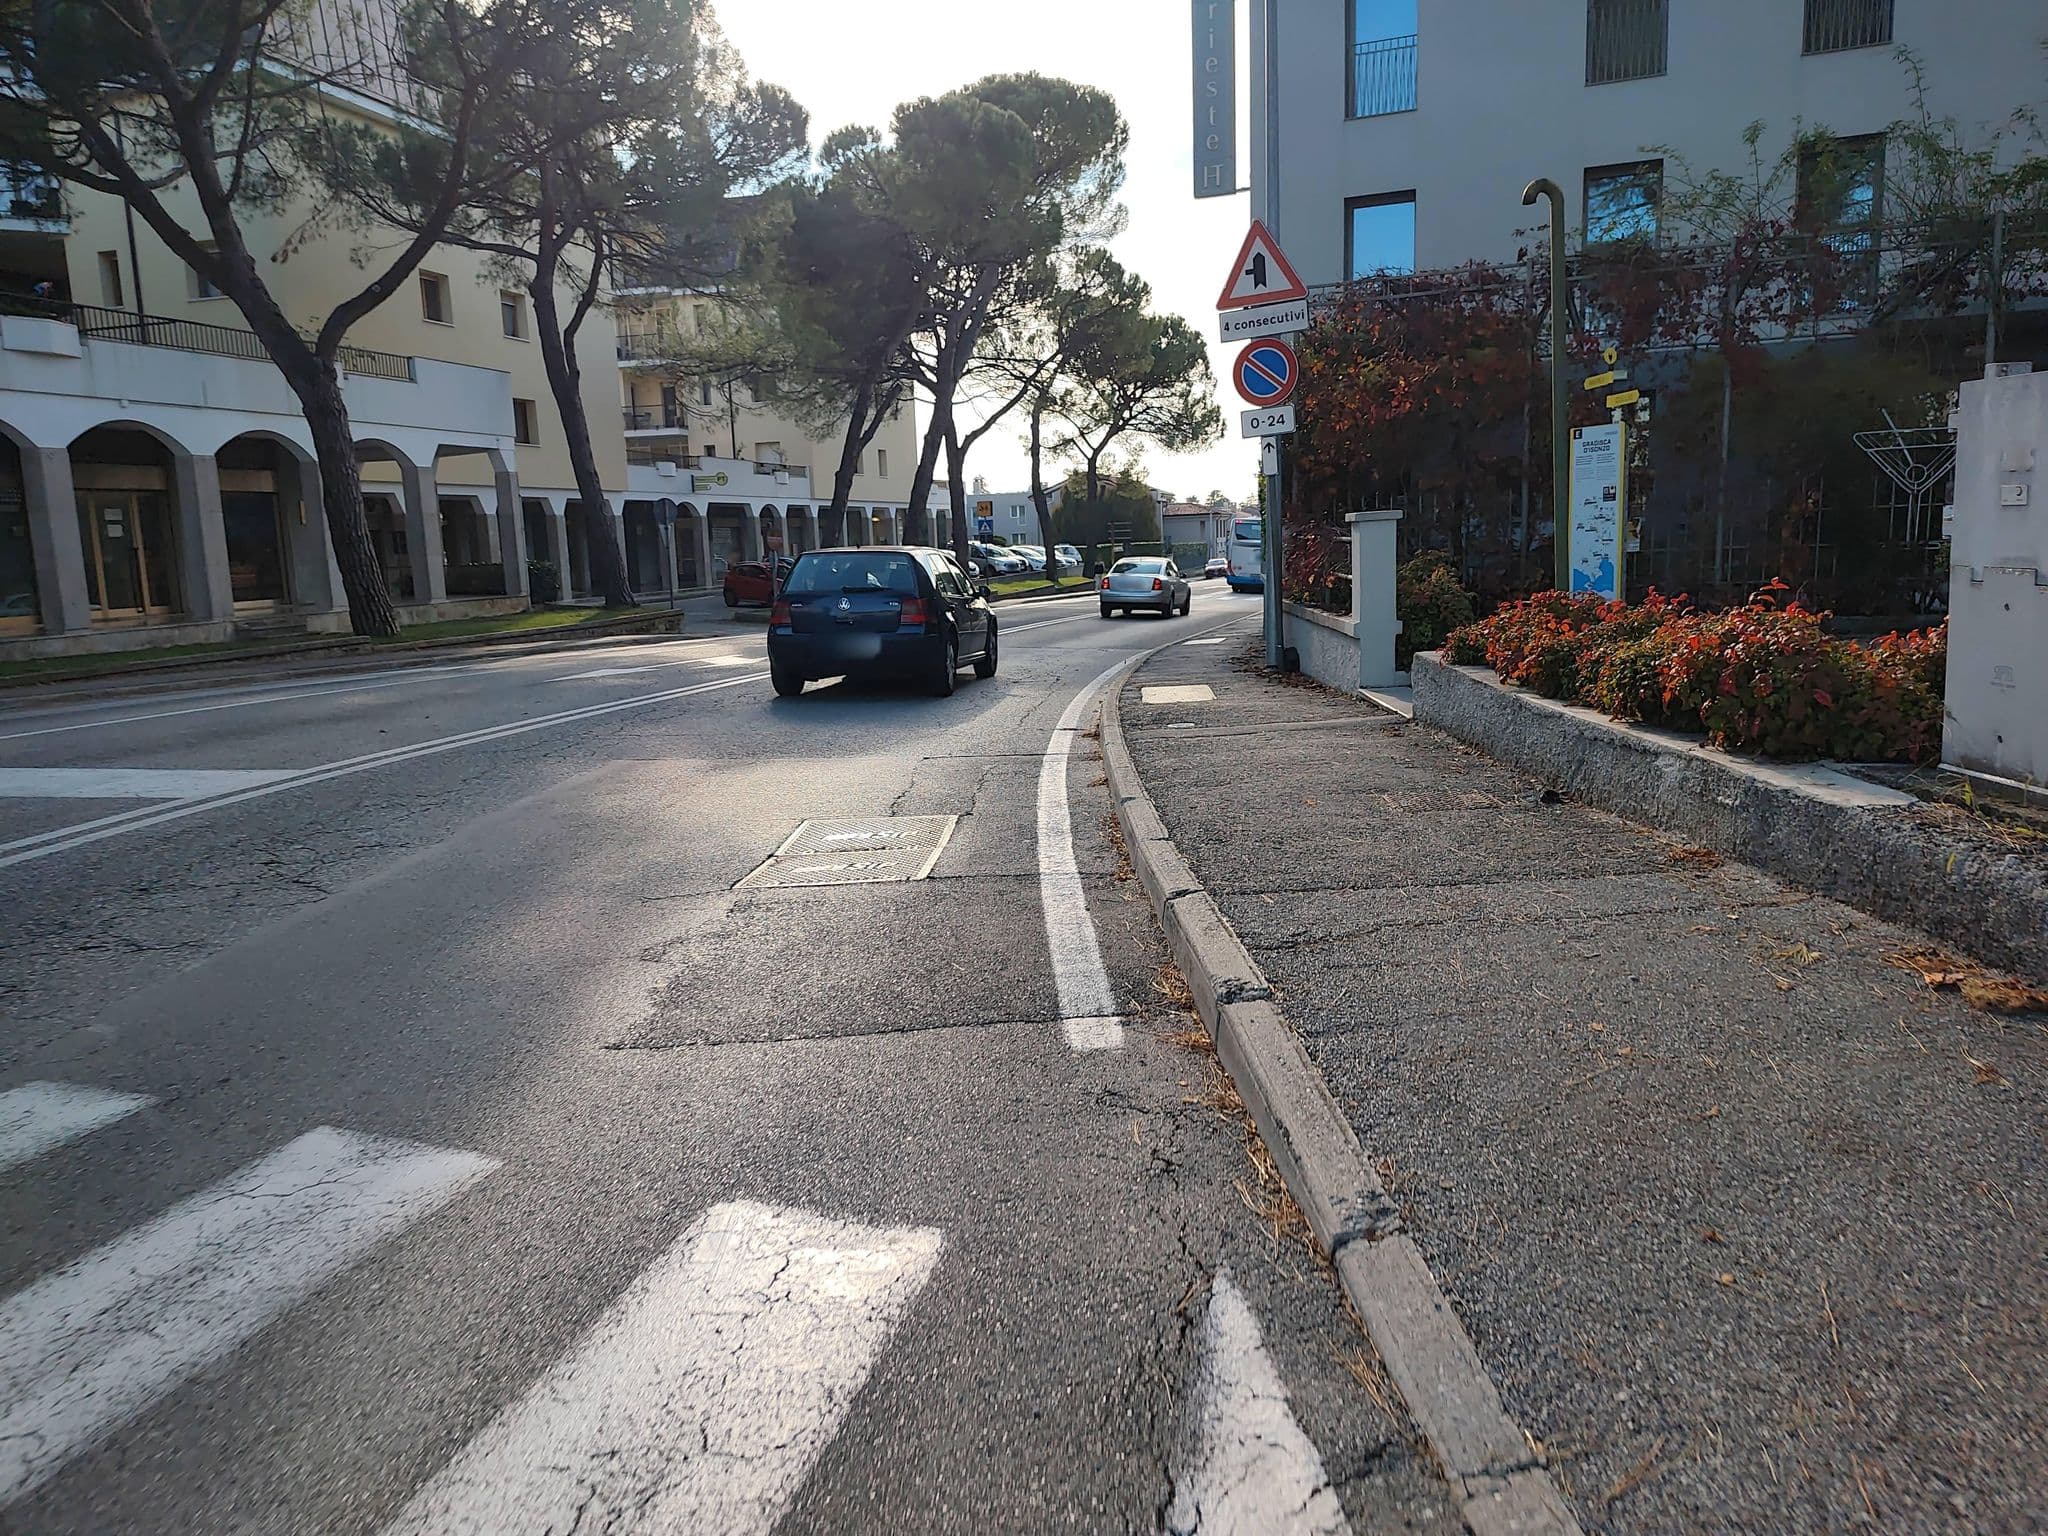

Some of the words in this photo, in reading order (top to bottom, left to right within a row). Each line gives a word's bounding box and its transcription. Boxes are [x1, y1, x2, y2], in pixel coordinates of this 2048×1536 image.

[1223, 321, 1230, 332] 4
[1234, 309, 1305, 331] consecutivi
[1250, 414, 1286, 429] 0-24
[1582, 438, 1612, 448] GRADISCA
[1583, 445, 1611, 454] D'ISONZO
